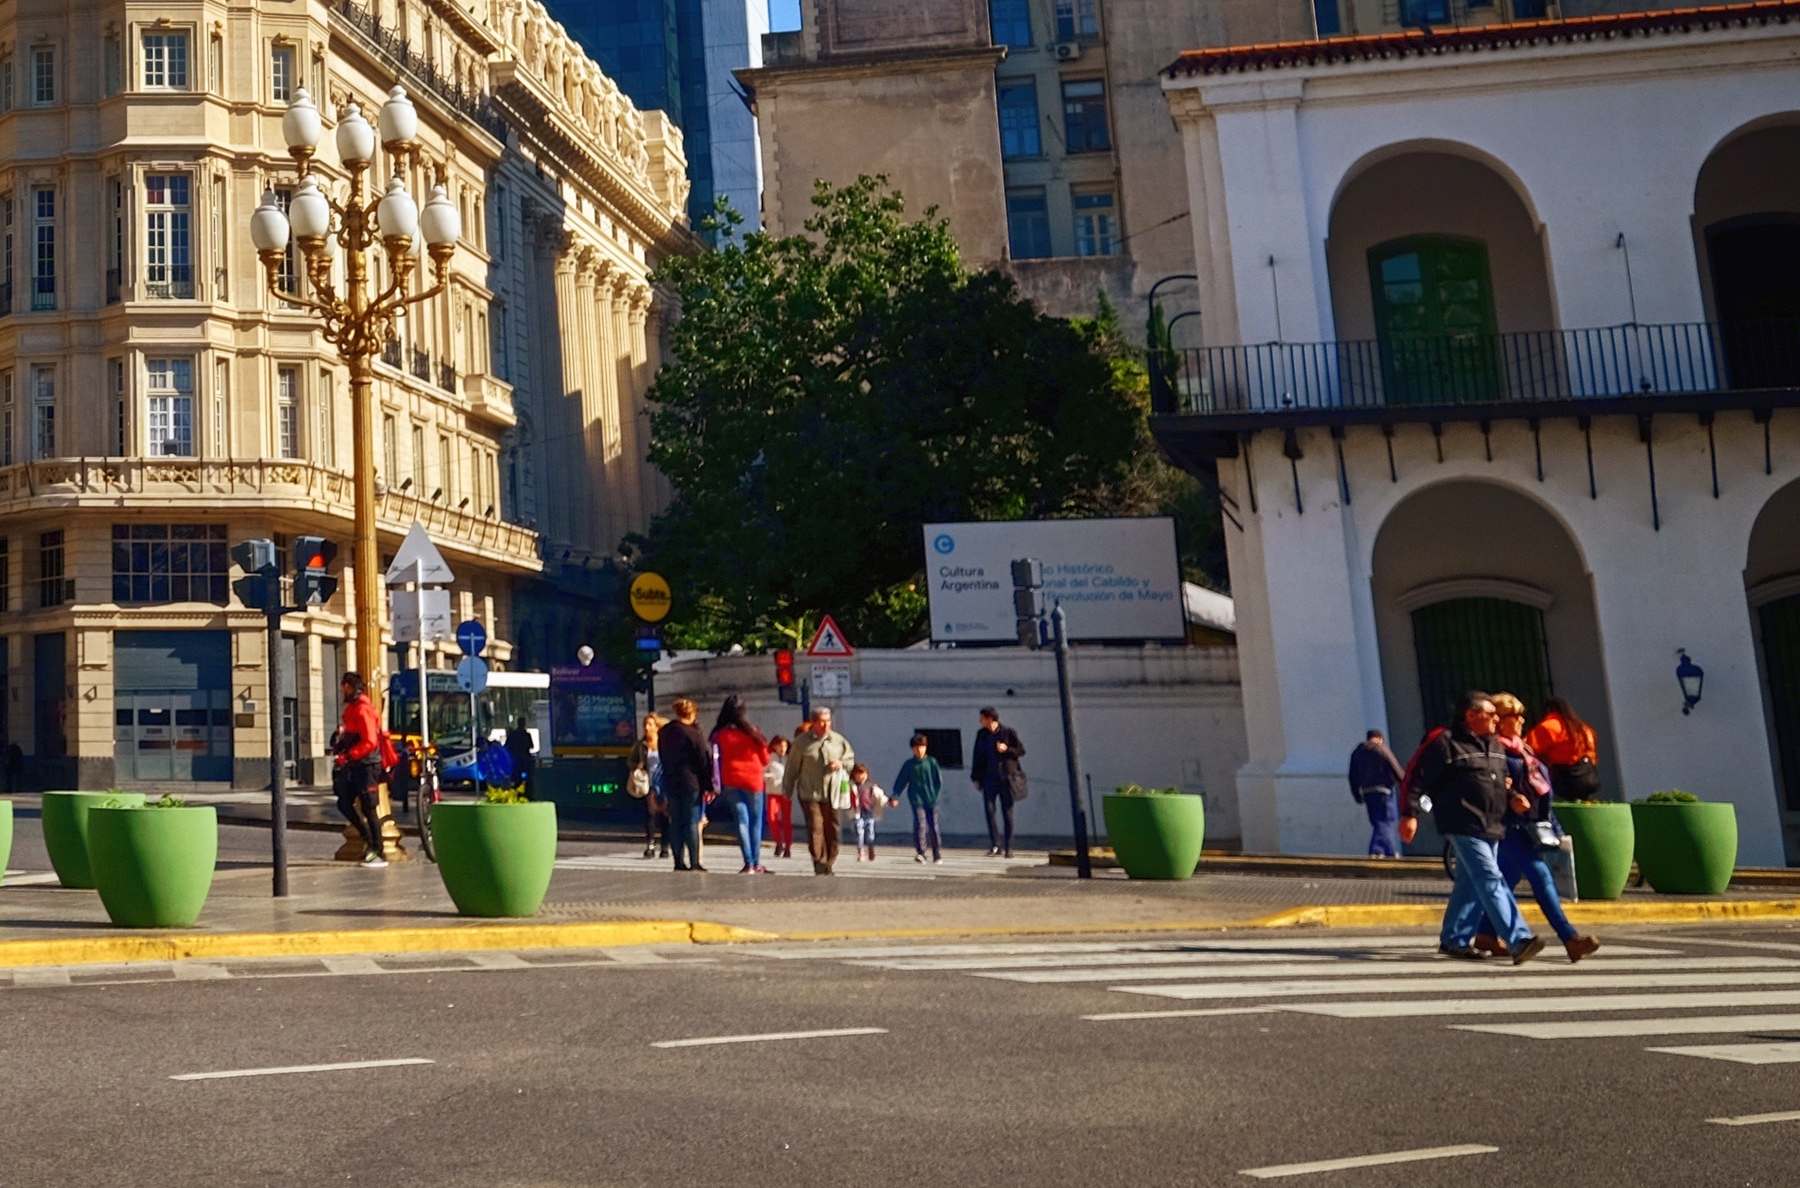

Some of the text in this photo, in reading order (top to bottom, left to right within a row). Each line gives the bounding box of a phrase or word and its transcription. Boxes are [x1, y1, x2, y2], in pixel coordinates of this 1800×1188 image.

[940, 566, 984, 578] Cultura
[941, 580, 999, 593] Argentina
[1092, 576, 1139, 588] Cabildo
[1138, 589, 1174, 602] Mayo
